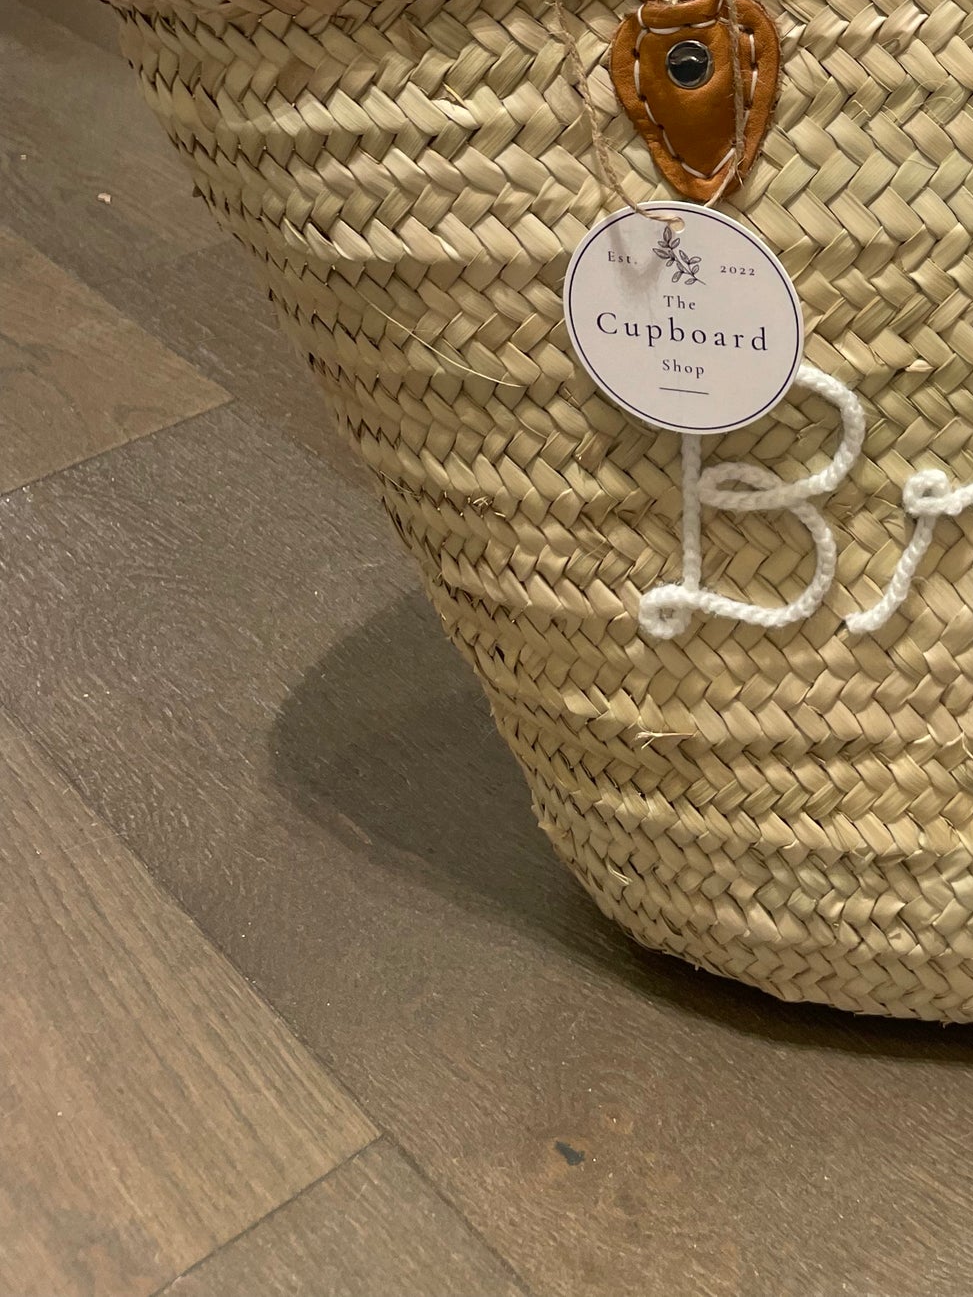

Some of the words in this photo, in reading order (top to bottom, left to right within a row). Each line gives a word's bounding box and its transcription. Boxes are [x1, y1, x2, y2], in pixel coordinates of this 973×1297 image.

[607, 250, 639, 266] Est.
[719, 264, 756, 277] 2022
[662, 294, 697, 311] The
[595, 311, 769, 352] Cupboard
[661, 358, 705, 379] Shop
